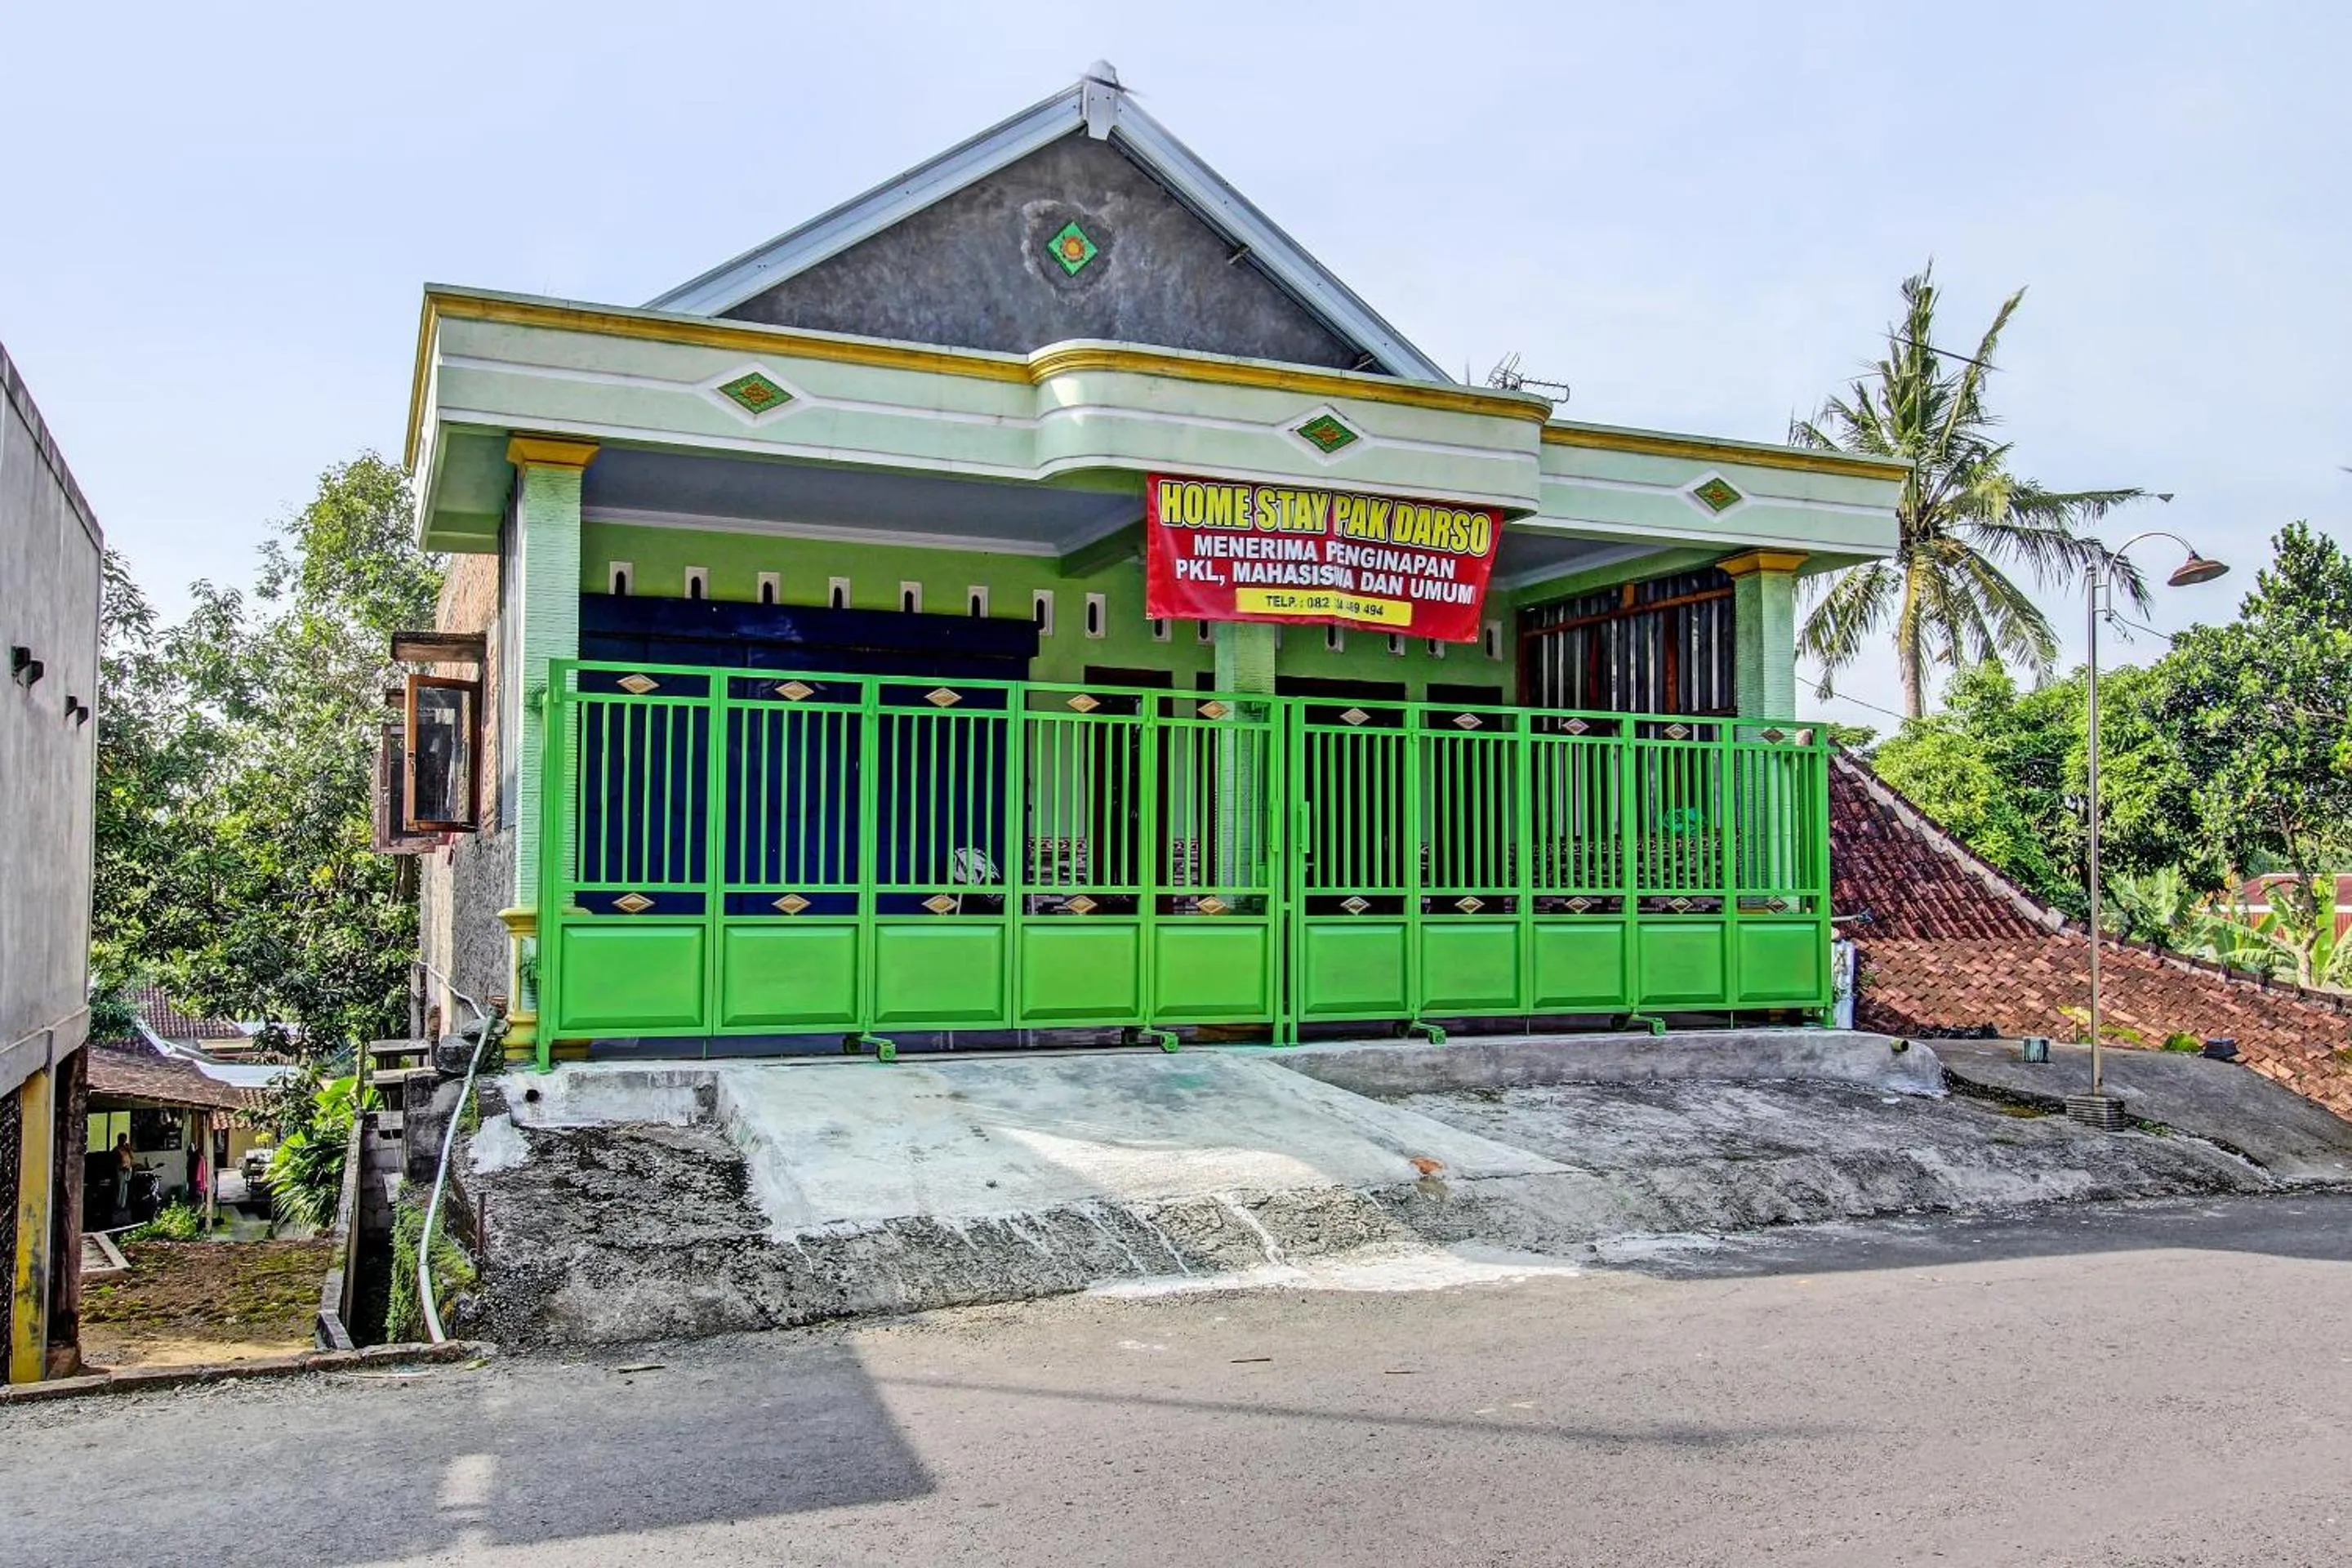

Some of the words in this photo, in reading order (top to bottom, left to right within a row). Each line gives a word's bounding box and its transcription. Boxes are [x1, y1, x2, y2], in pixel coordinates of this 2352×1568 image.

[1159, 480, 1252, 530] HOME
[1254, 486, 1331, 534] STAY
[1332, 492, 1392, 542] PAK
[1390, 501, 1492, 557] DARSO
[1194, 534, 1318, 561] MENERIMA
[1326, 541, 1456, 580] PENGINAPAN
[1176, 559, 1226, 586] PKL,
[1232, 561, 1354, 590] MAHASISWA
[1361, 572, 1404, 596] DAN
[1410, 577, 1477, 605] UMUM
[1307, 596, 1330, 609] 082
